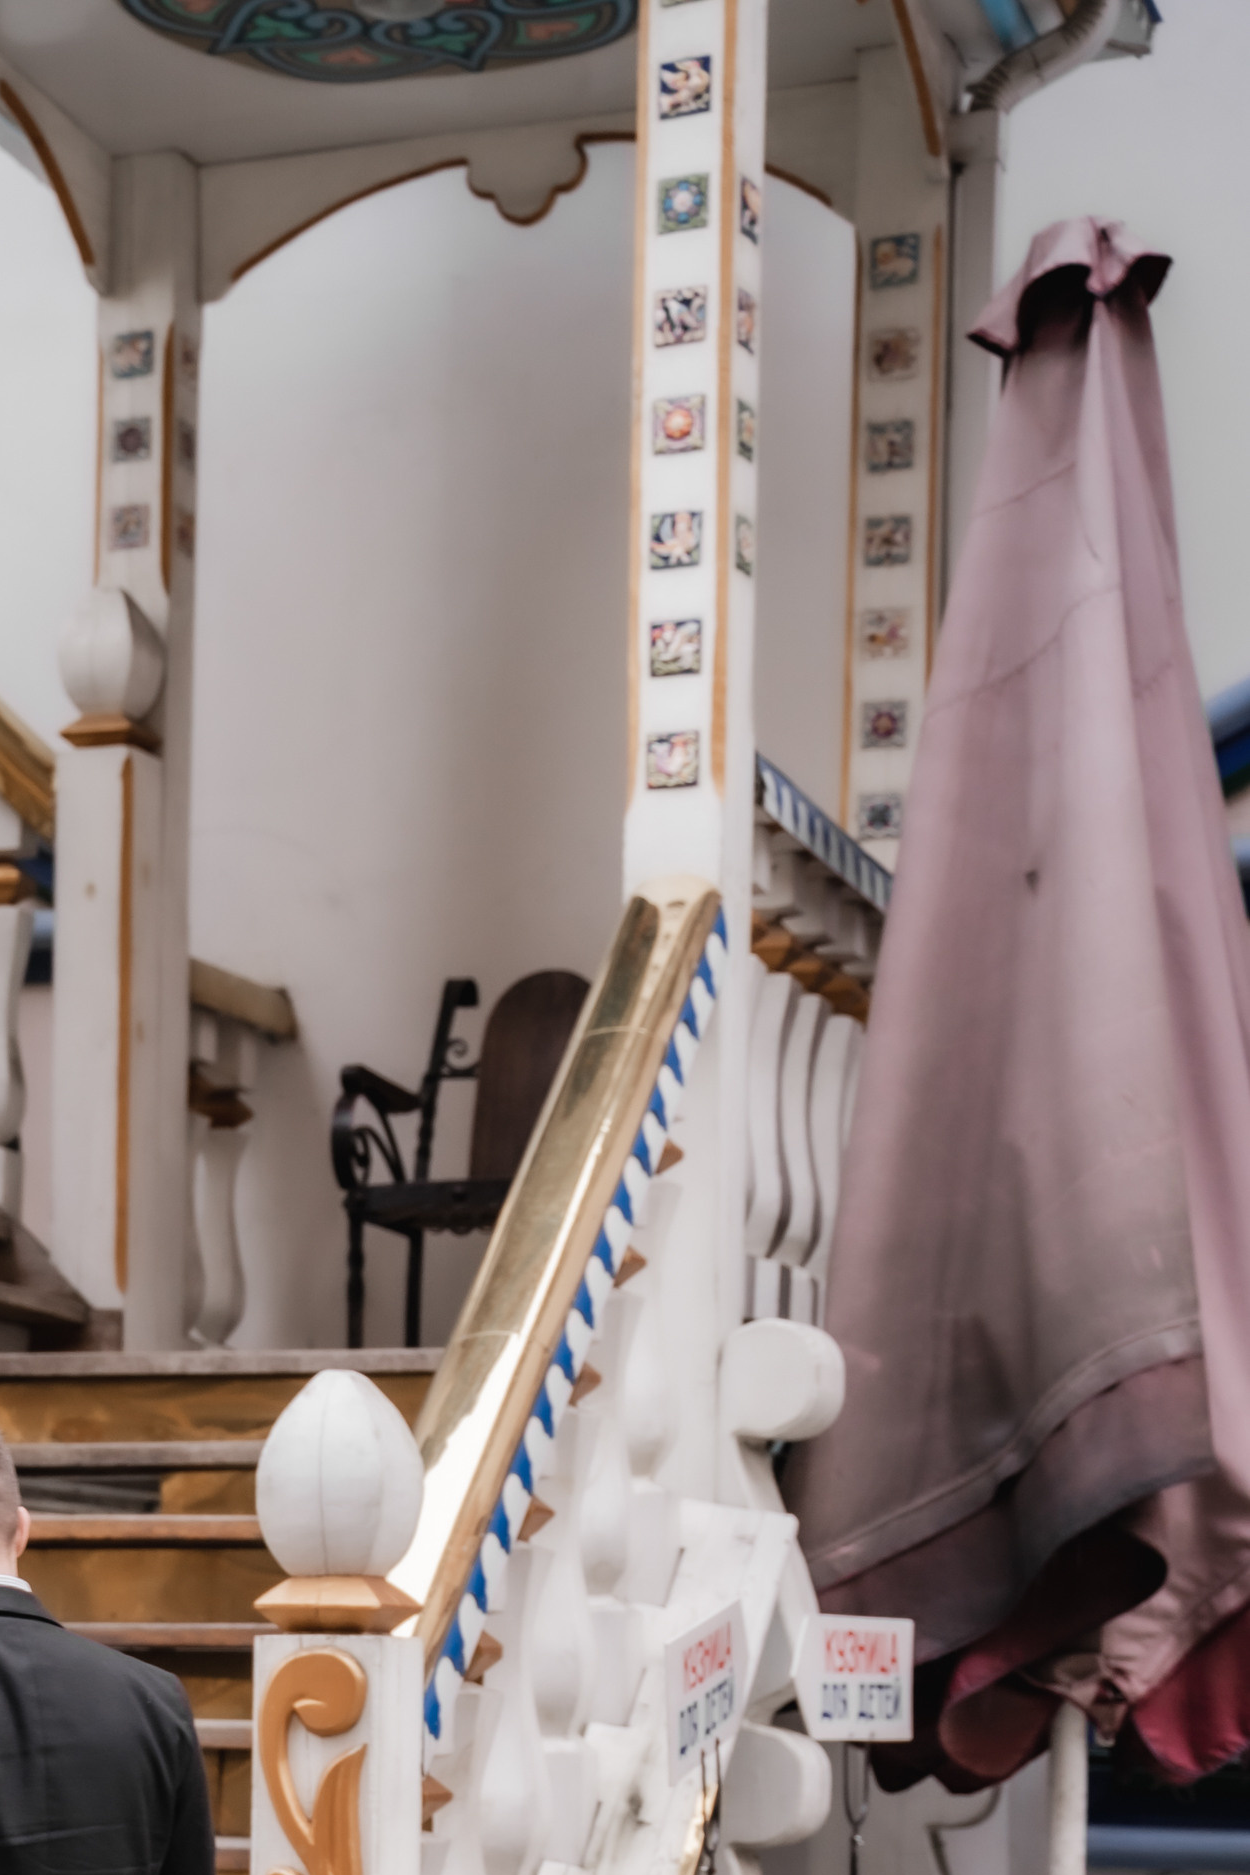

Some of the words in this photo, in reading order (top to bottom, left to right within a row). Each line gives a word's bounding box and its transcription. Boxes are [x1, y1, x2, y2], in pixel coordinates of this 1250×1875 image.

[824, 1630, 900, 1675] КУЗНИЦА
[822, 1683, 848, 1719] ДЛЯ
[858, 1676, 901, 1719] ДЕТЕЙ
